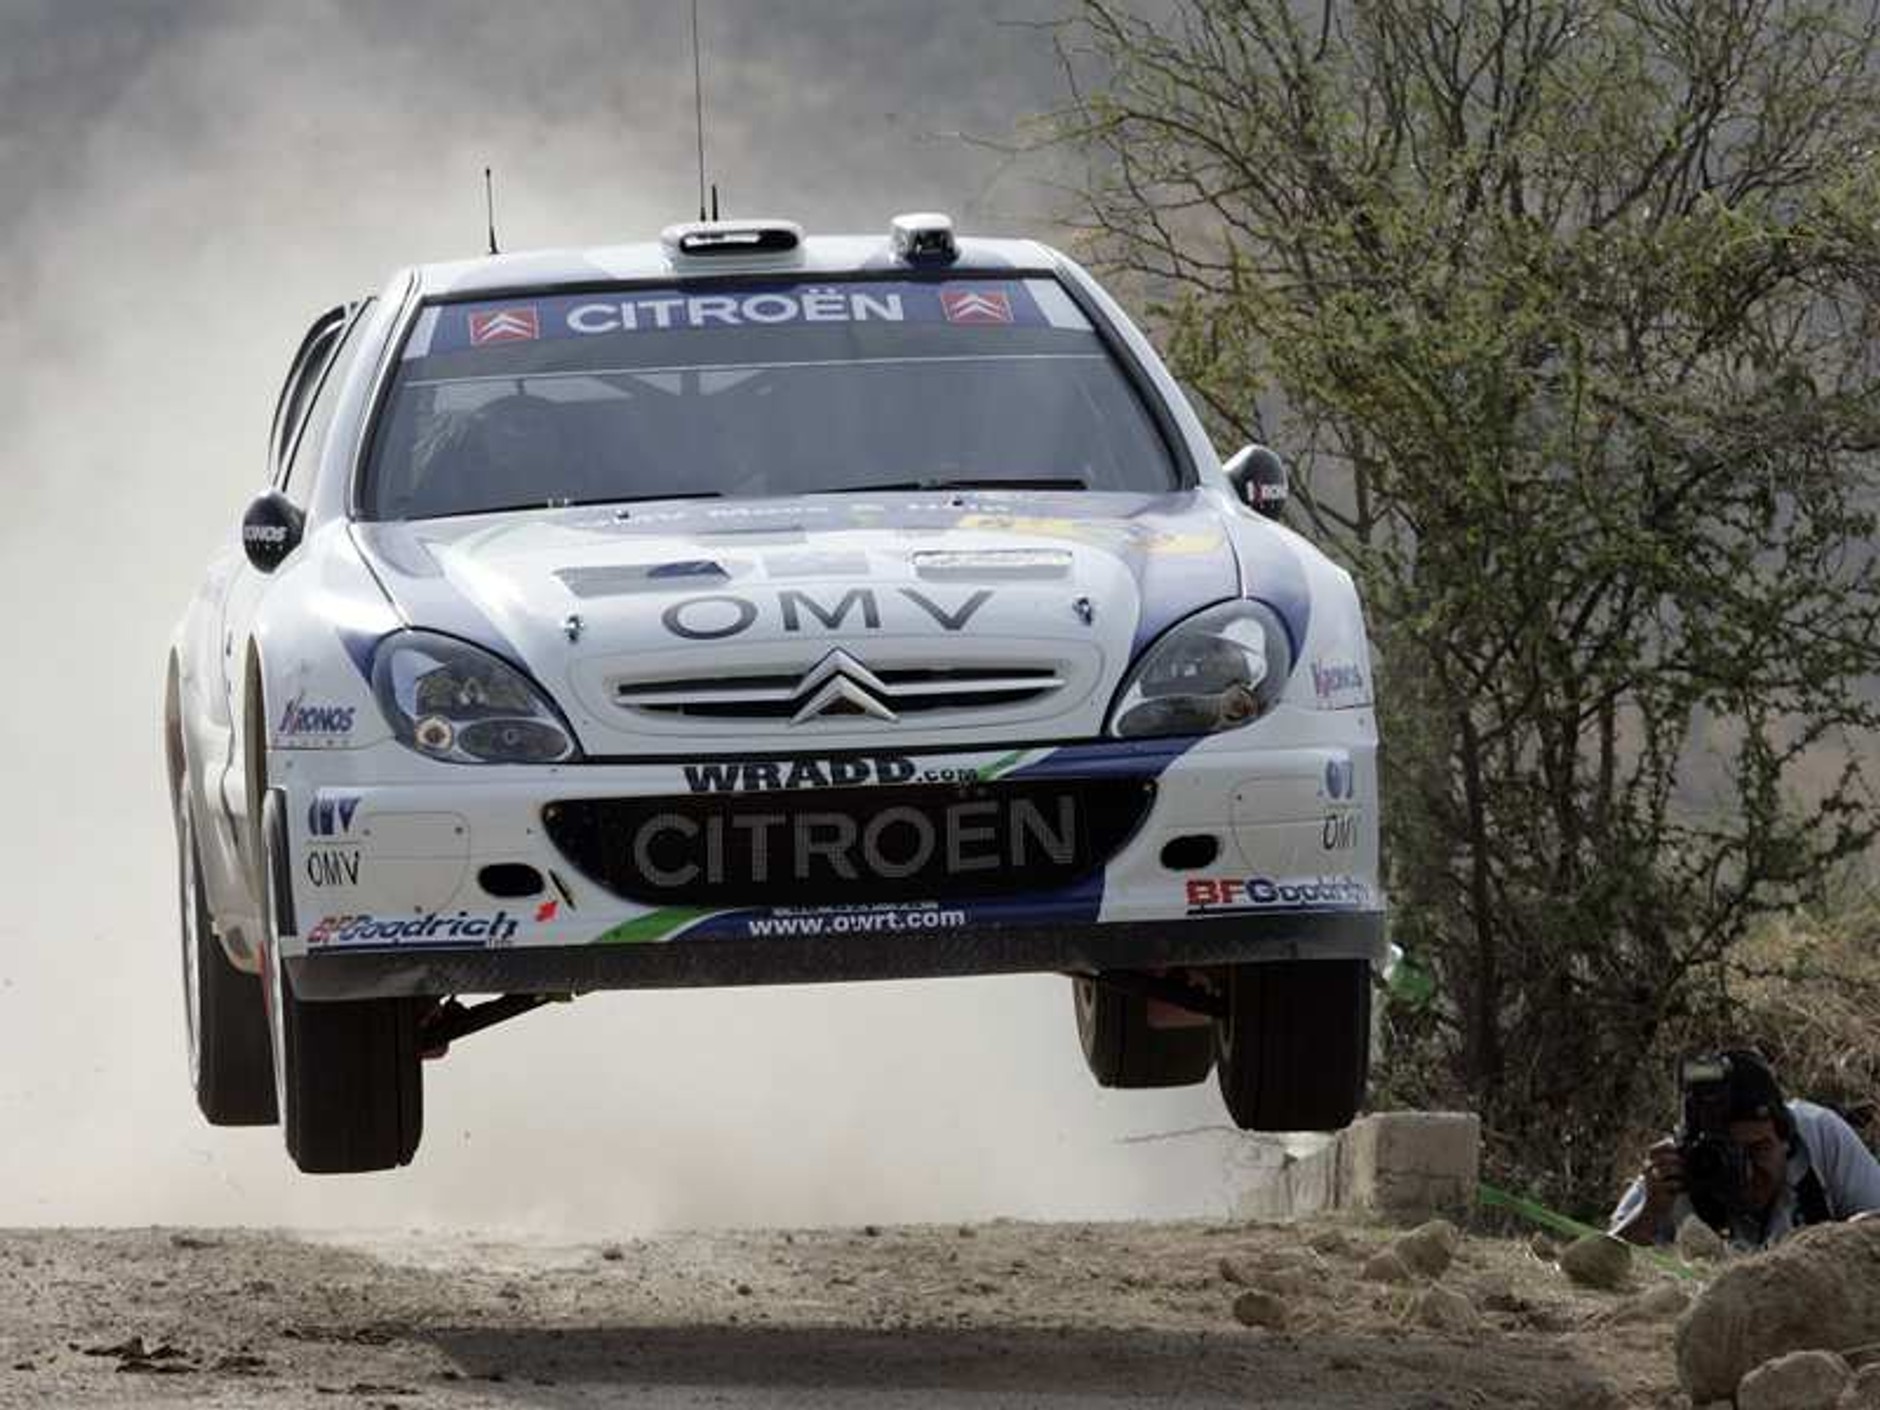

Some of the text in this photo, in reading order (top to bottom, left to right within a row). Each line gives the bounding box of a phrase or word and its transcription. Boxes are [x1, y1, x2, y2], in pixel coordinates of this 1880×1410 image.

[566, 288, 904, 333] CITROËN
[661, 587, 996, 640] OMV
[633, 785, 1075, 888] CITROËN
[307, 850, 359, 887] OMV
[749, 909, 965, 936] www.owrt.com
